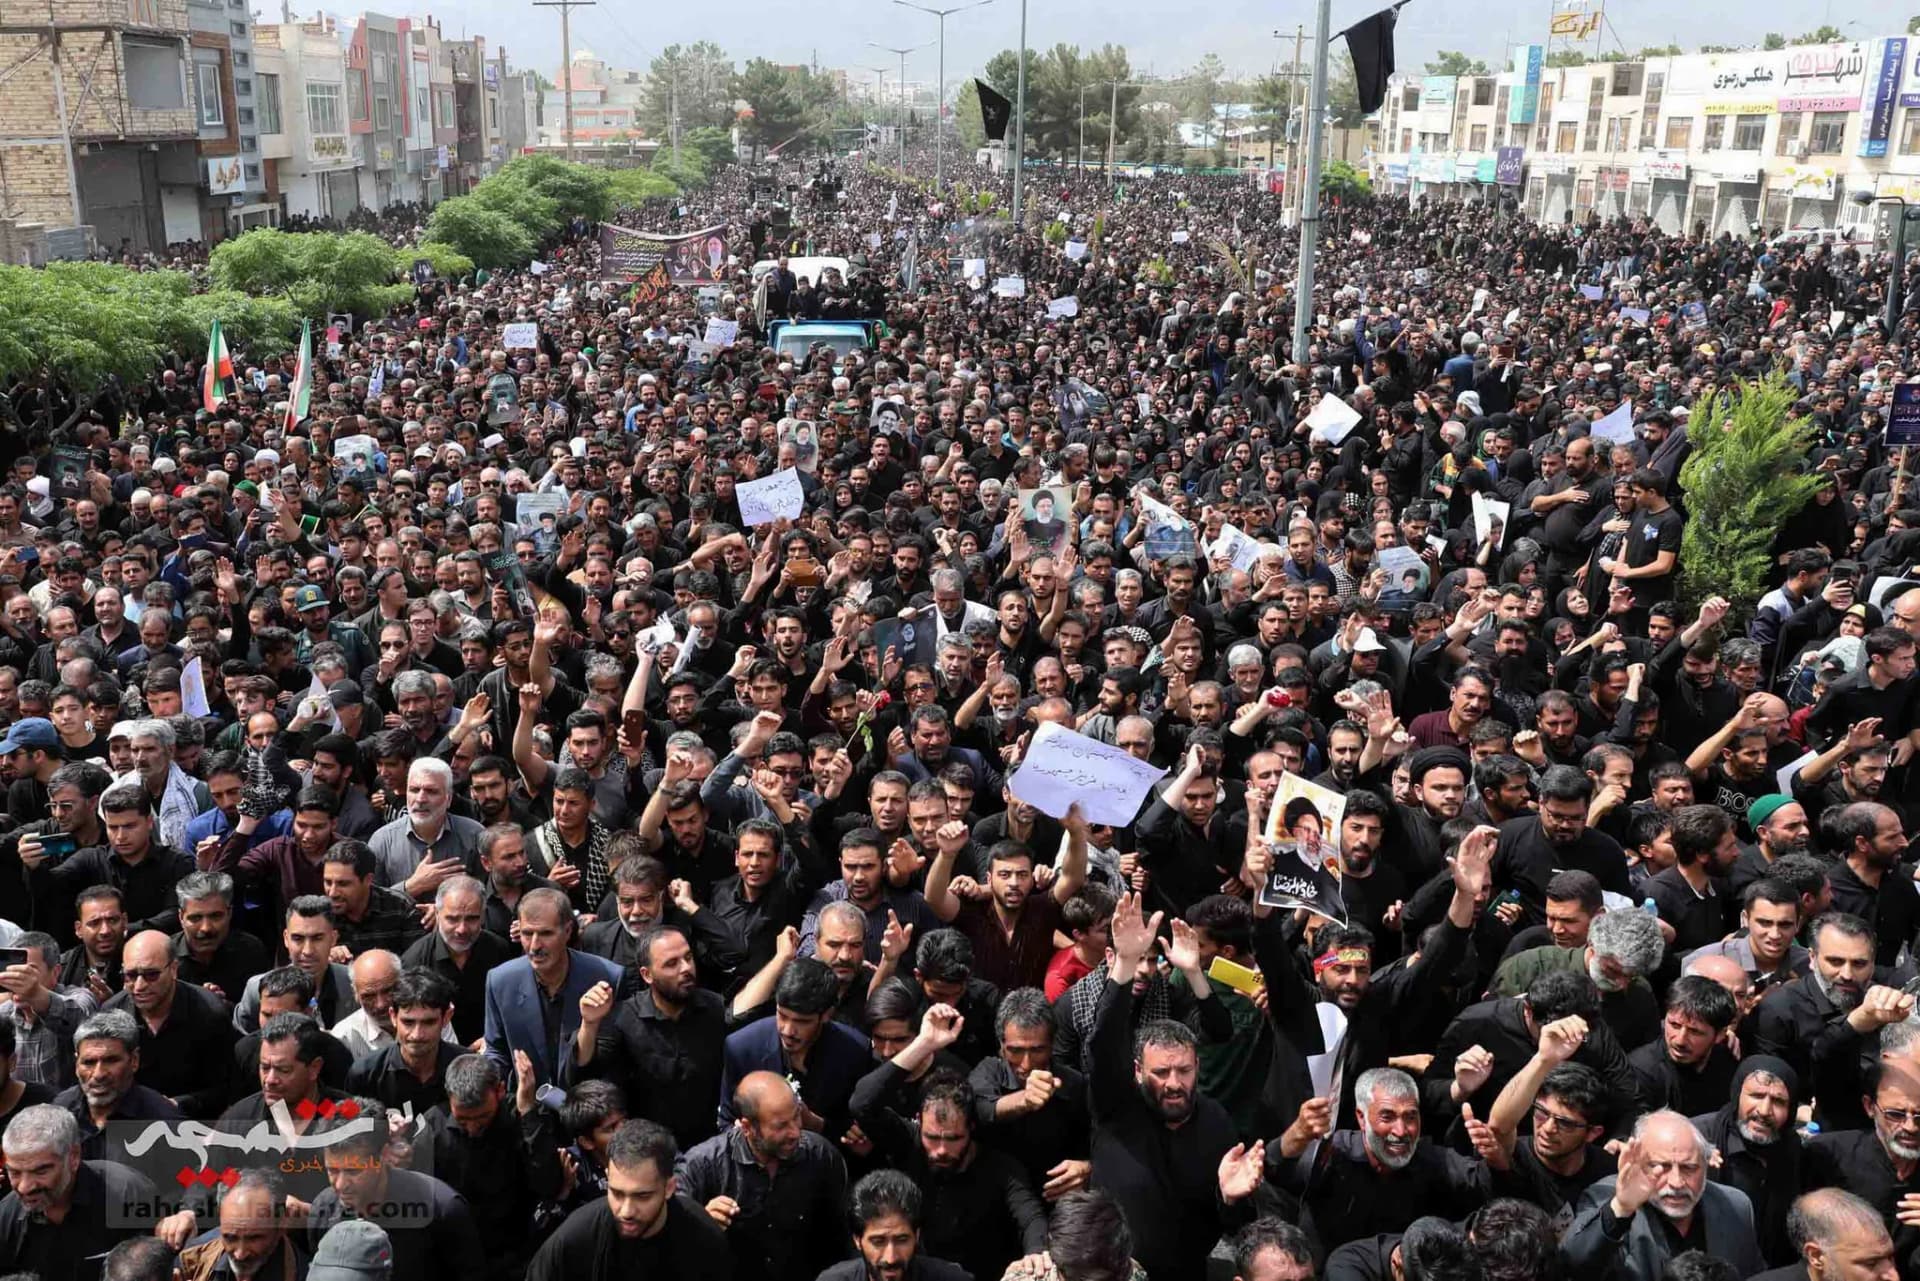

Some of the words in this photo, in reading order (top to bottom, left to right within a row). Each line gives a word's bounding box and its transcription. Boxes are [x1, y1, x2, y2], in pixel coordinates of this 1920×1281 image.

[1783, 42, 1863, 87] شهر
[1272, 873, 1300, 896] الرضا
[1298, 877, 1318, 899] خادم
